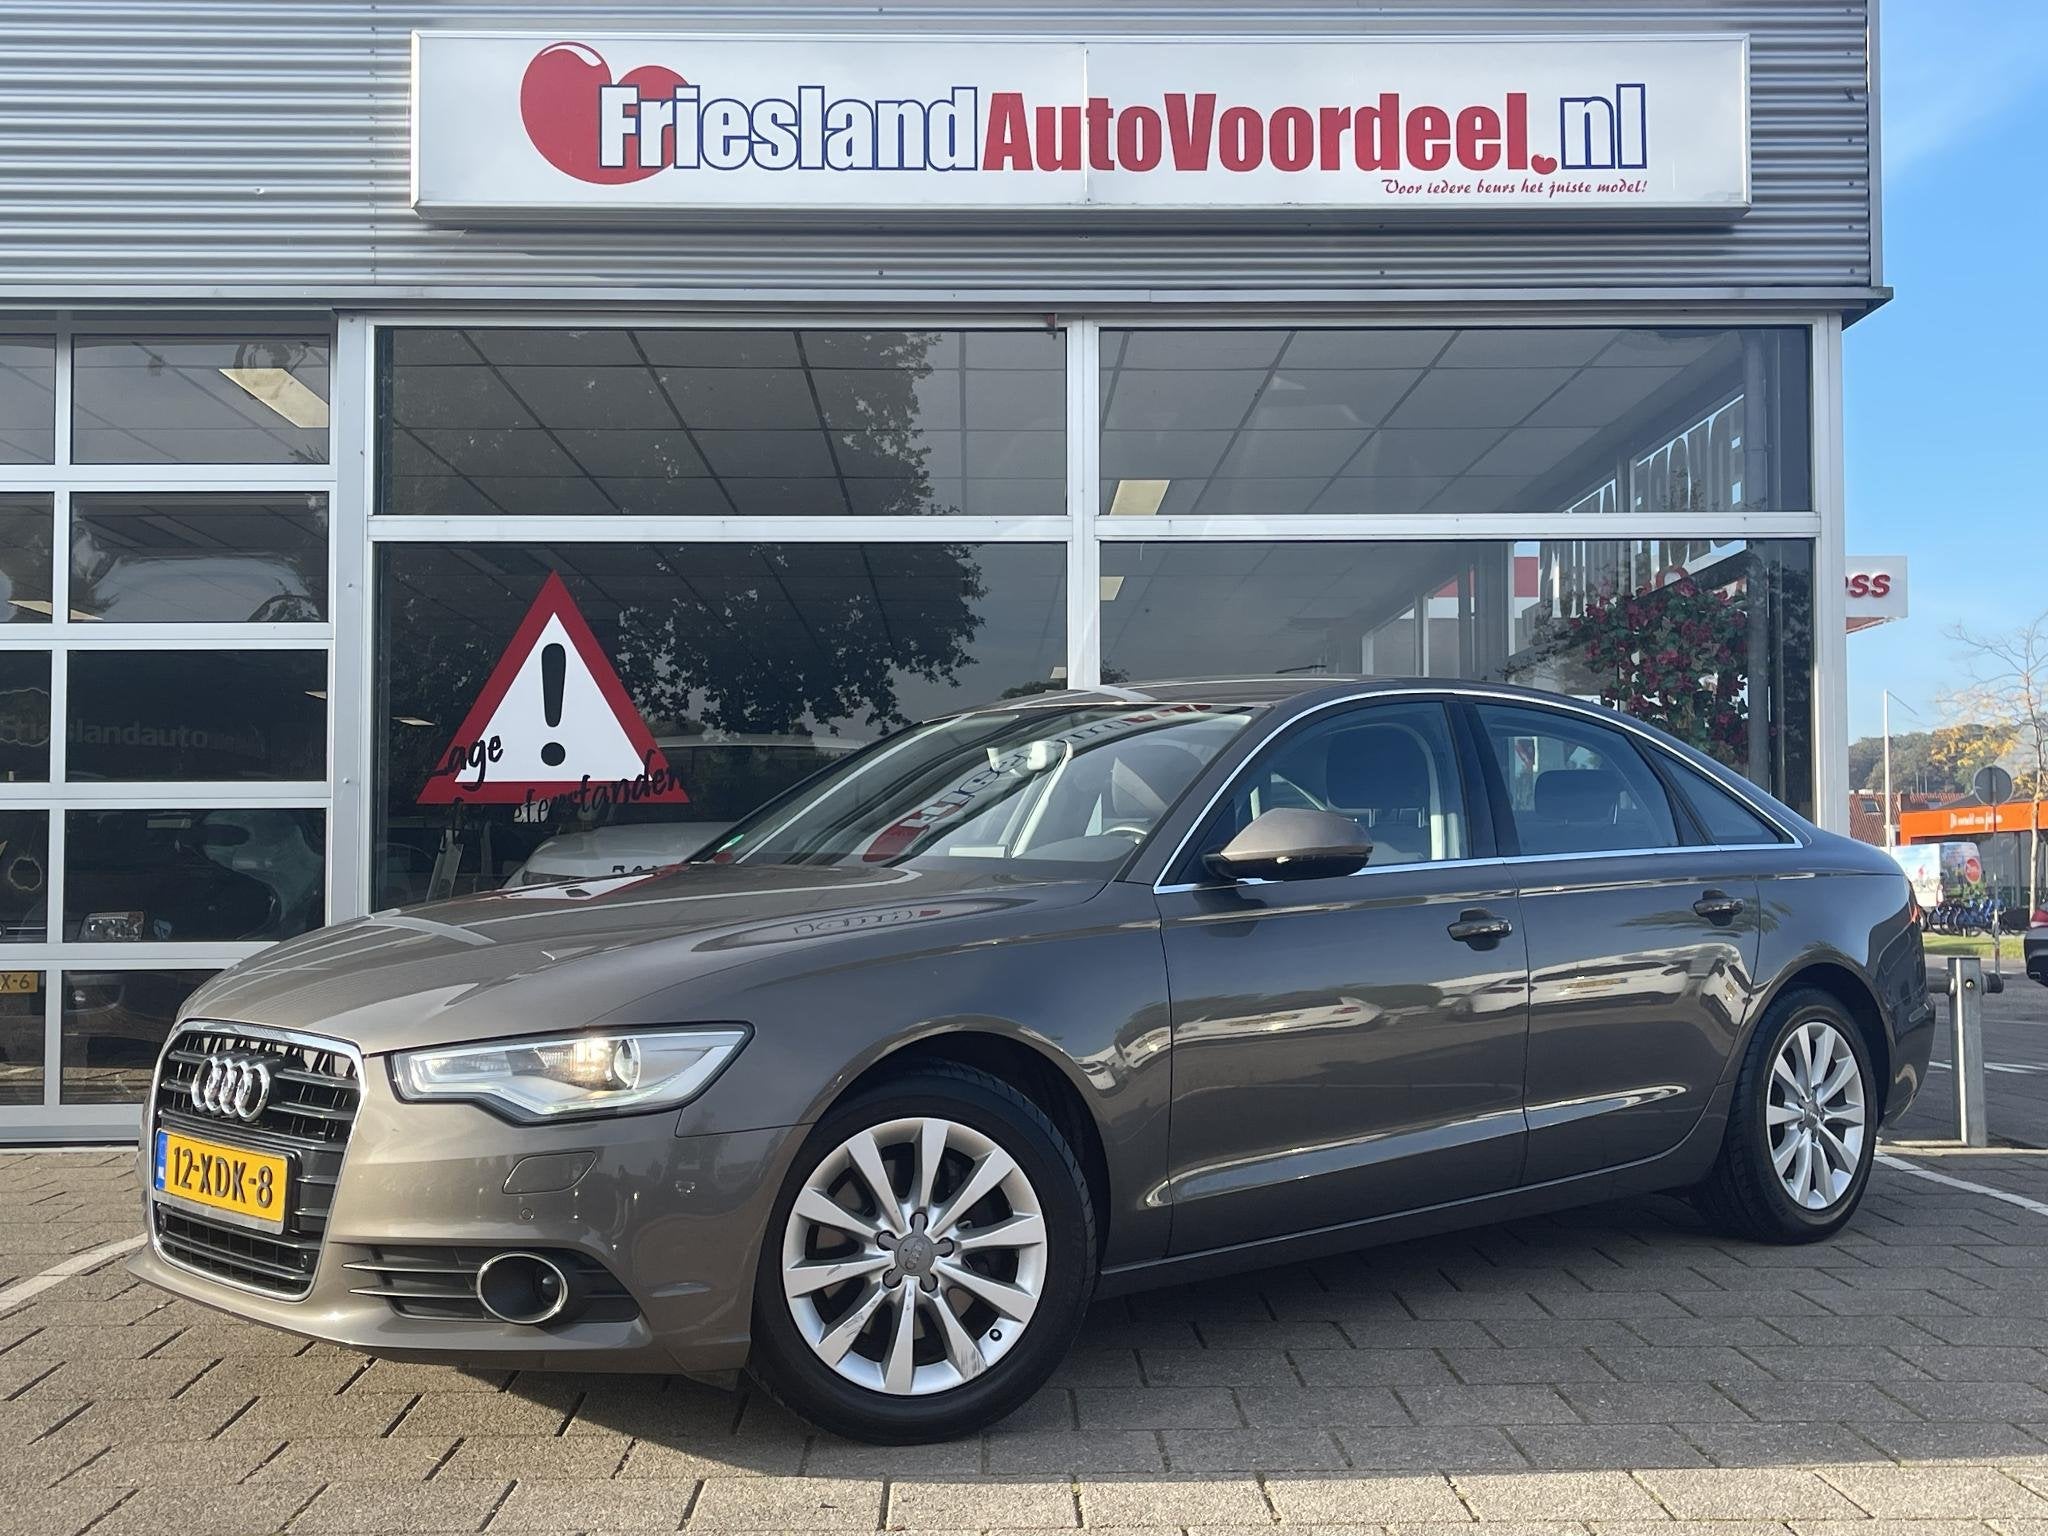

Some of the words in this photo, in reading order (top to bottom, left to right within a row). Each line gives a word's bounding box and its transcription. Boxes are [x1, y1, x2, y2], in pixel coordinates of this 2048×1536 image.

[1381, 178, 1423, 194] Voor
[1427, 178, 1472, 194] iedere
[1477, 178, 1516, 194] beurs
[1520, 178, 1545, 193] het
[1548, 178, 1592, 198] juiste
[1596, 178, 1648, 193] model!
[1845, 574, 1891, 598] ss
[173, 1146, 273, 1208] 12-XDK-8
